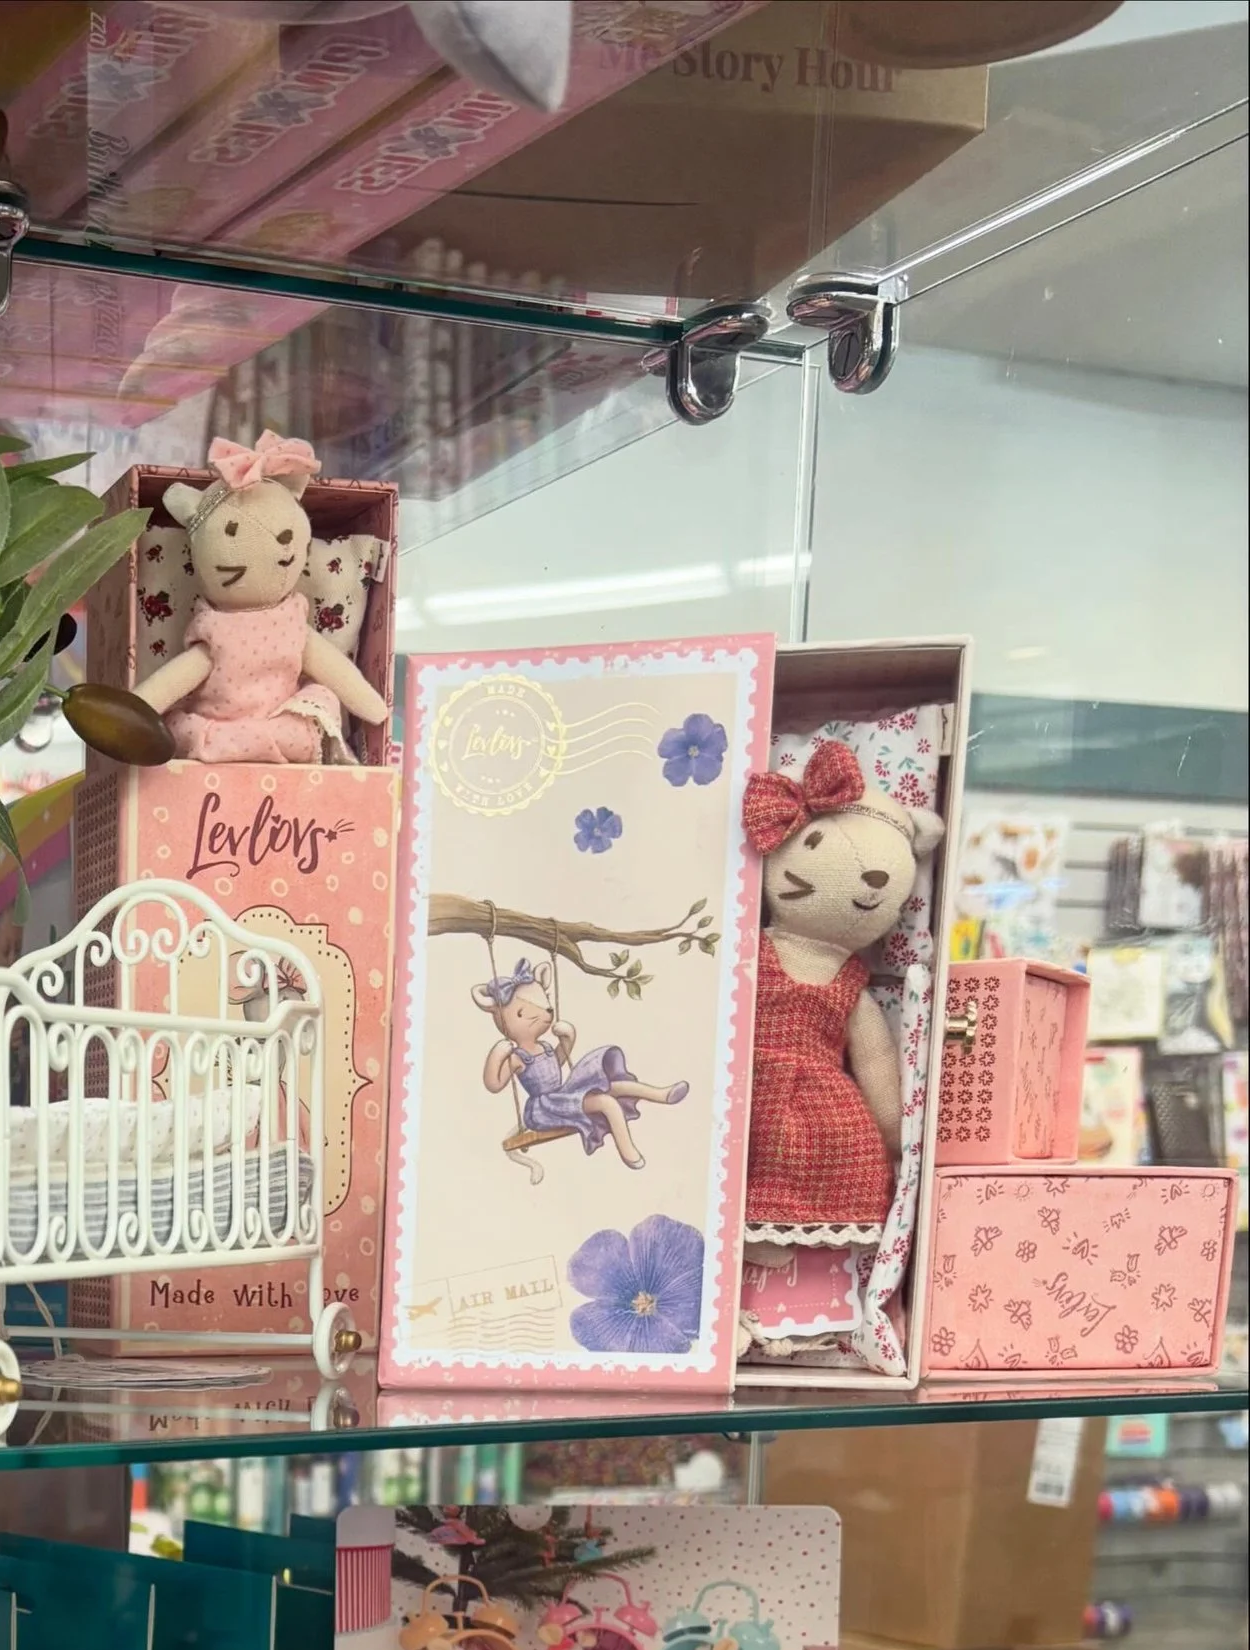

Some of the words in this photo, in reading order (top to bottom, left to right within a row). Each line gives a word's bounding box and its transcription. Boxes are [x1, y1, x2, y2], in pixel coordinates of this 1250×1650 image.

[672, 42, 785, 93] Story
[186, 791, 325, 880] Levlovs
[150, 1279, 215, 1309] Made
[233, 1281, 293, 1308] With
[323, 1287, 359, 1308] ove
[458, 1293, 495, 1312] AIR
[505, 1280, 554, 1303] MAIL
